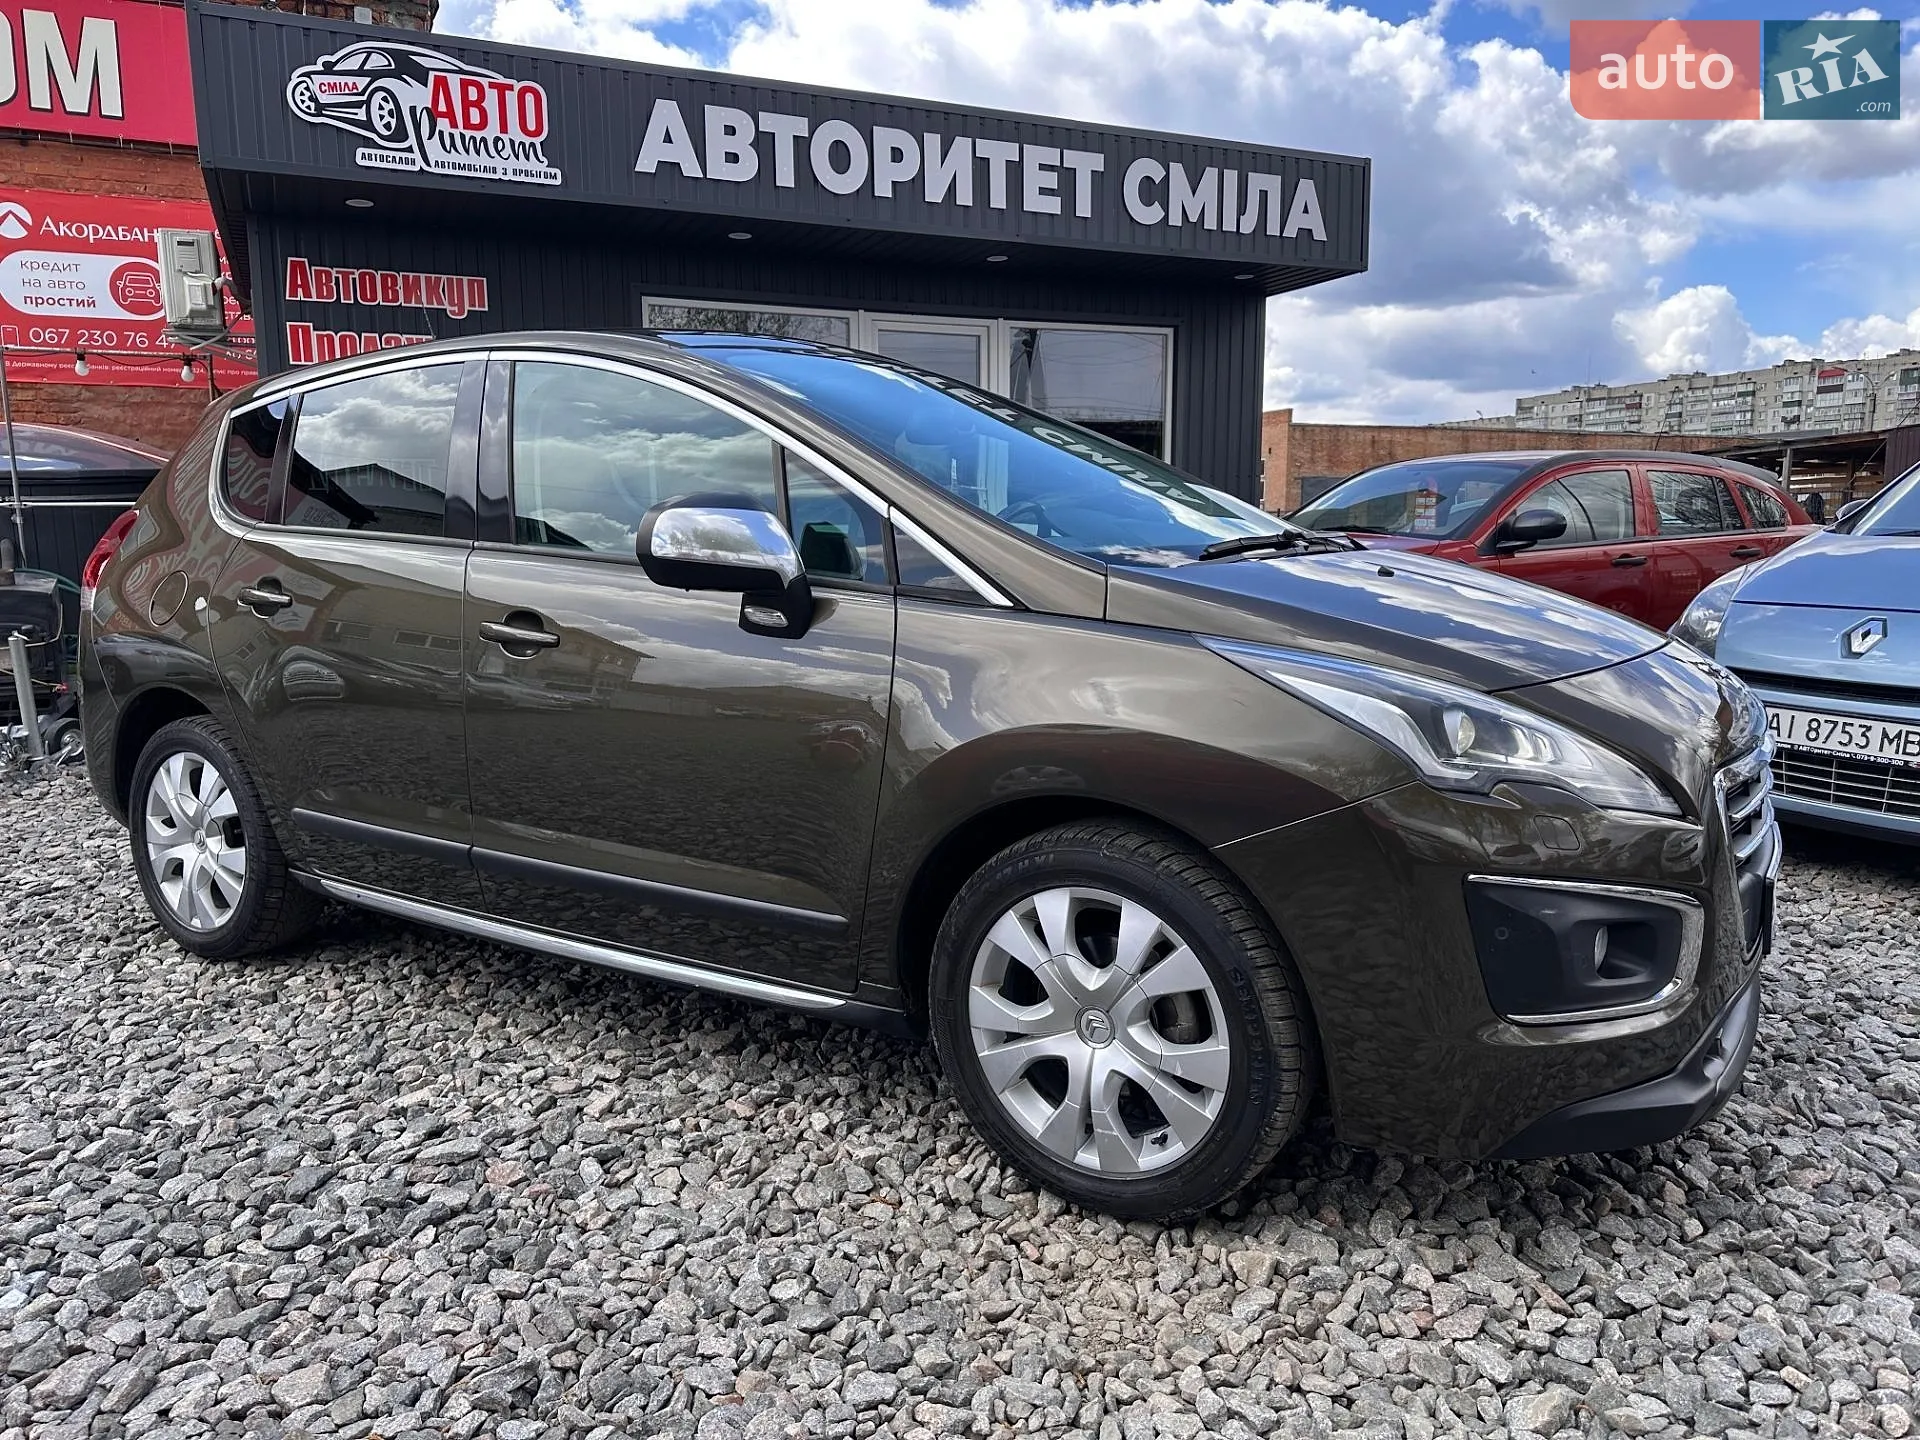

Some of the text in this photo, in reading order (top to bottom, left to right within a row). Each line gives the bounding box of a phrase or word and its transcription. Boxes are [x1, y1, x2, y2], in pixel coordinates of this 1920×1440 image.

[318, 81, 359, 95] СМІЛА
[430, 74, 545, 138] АВТО
[360, 151, 417, 167] АВТОСАЛОН
[433, 160, 498, 176] АВТОМОБІЛІВ
[512, 167, 558, 181] ПРОБІГОМ
[634, 98, 1329, 242] АВТОРИТЕТ СМІЛА
[20, 259, 81, 273] кредит
[22, 278, 86, 290] на авто
[286, 257, 488, 319] Автовикуп
[23, 294, 97, 308] простий
[29, 327, 69, 344] 067
[77, 329, 117, 347] 230
[123, 331, 149, 348] 76
[1805, 718, 1872, 749] 8753
